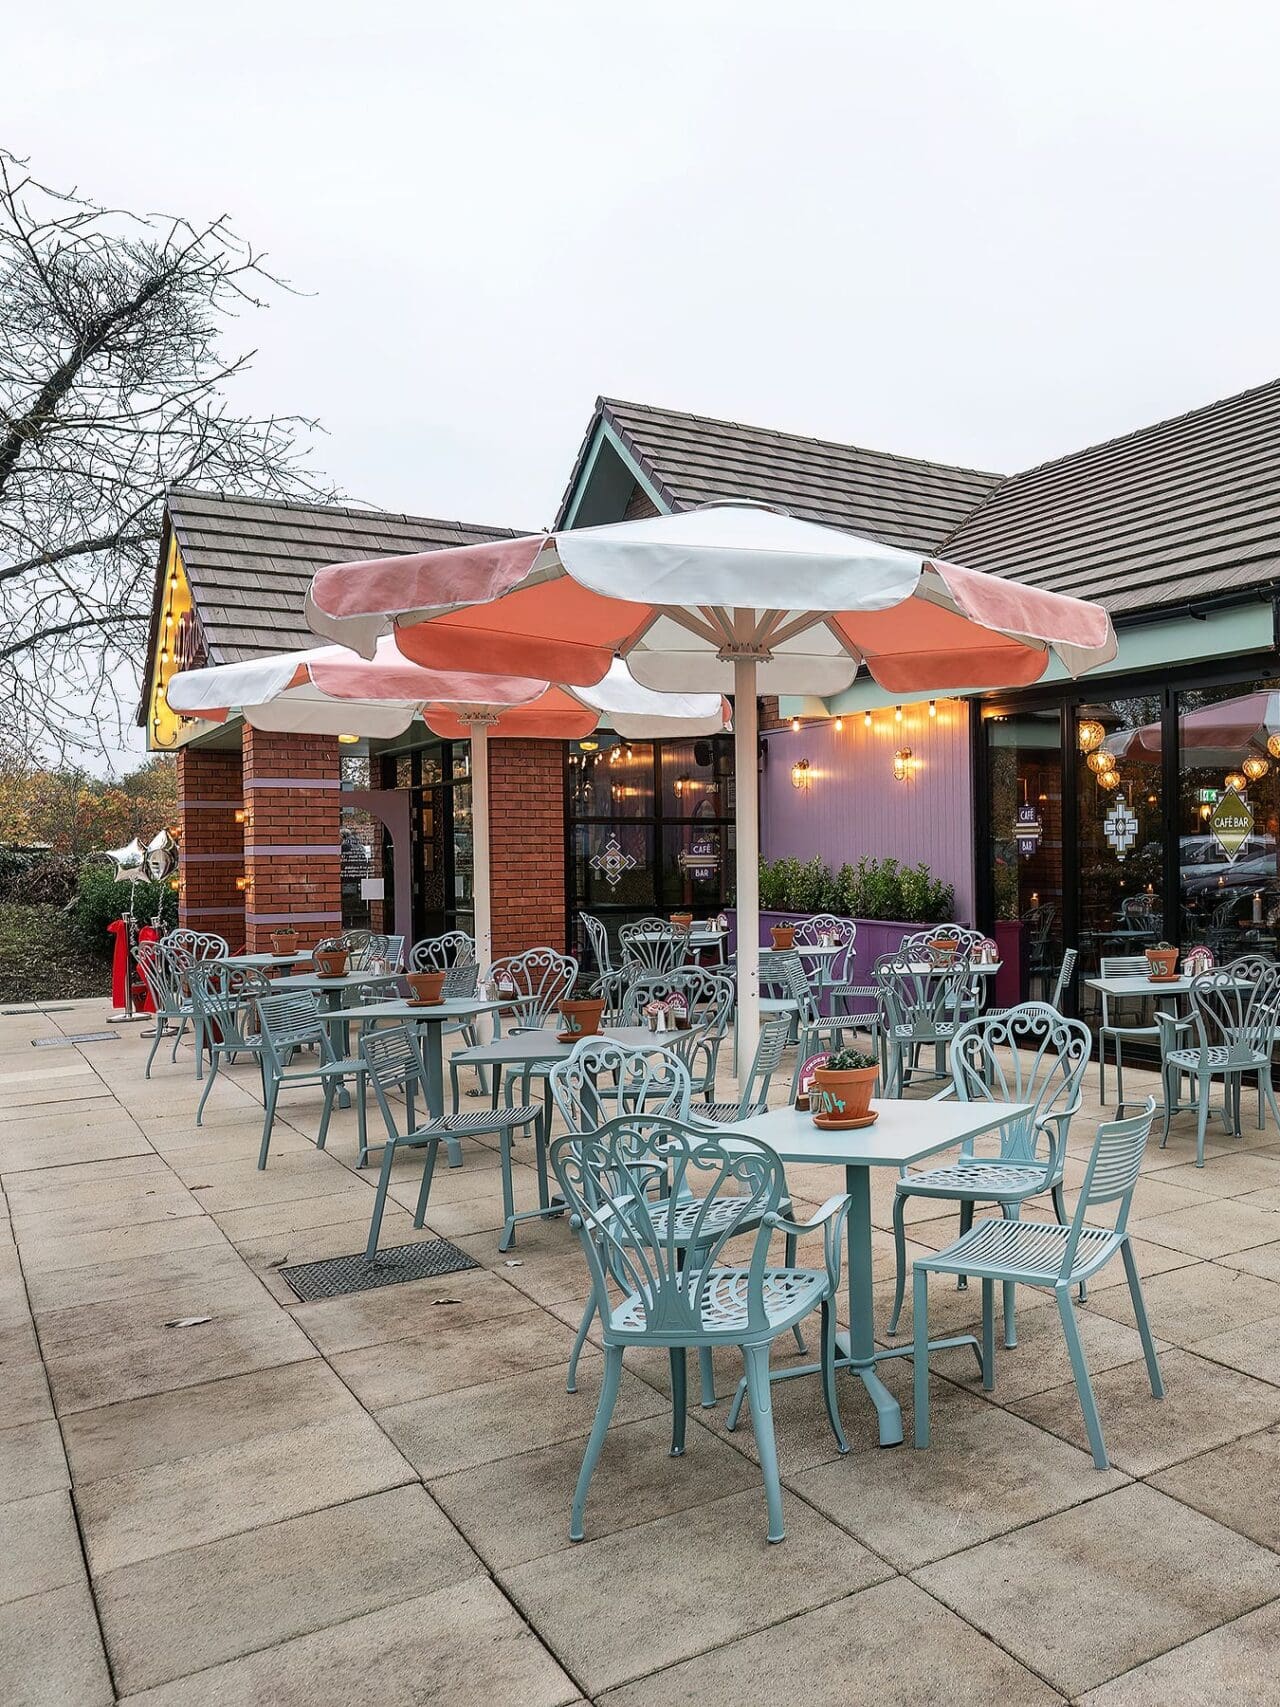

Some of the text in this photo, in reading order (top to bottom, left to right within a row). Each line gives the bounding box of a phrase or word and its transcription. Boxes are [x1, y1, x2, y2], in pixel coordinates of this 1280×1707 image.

[1020, 807, 1034, 820] CAFÉ
[1214, 815, 1249, 828] CAFÉ BAR
[692, 843, 711, 854] CAFÉ
[1021, 840, 1034, 851] BAR
[695, 868, 709, 877] BAR
